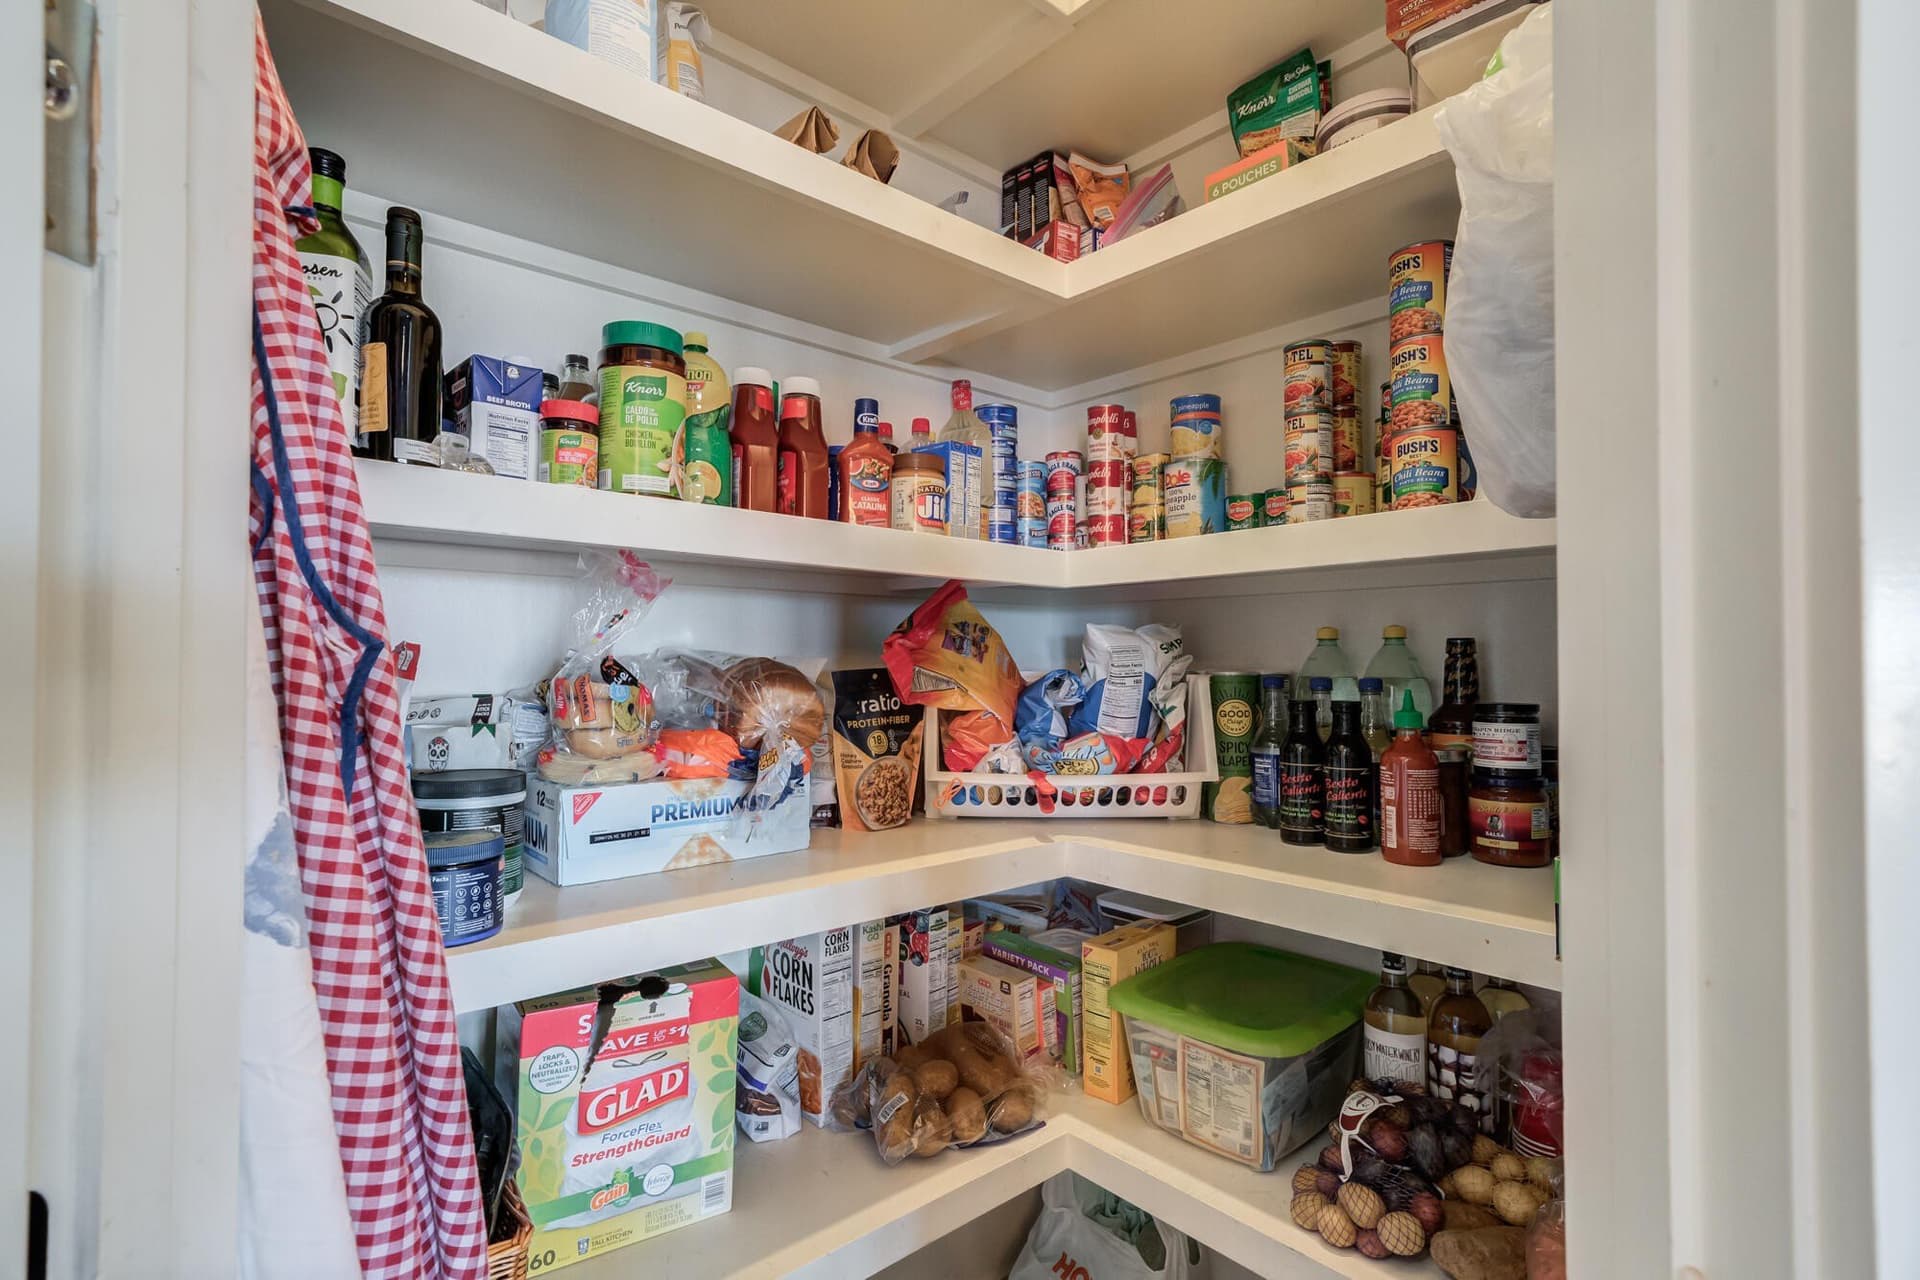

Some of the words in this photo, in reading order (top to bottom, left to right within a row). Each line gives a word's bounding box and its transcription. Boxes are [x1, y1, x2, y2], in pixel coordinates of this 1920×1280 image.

[1237, 95, 1277, 119] Knorr
[1212, 186, 1220, 197] 6
[1221, 160, 1278, 193] POUCHES
[302, 264, 343, 278] osen
[1391, 255, 1421, 277] USH'S
[625, 380, 664, 396] Knorr
[1404, 376, 1434, 386] Beans
[486, 395, 504, 404] BEEF
[505, 399, 531, 409] BROTH
[625, 405, 649, 414] CALDO
[625, 415, 634, 424] DE
[1397, 440, 1439, 458] BUSH'S
[1165, 469, 1191, 487] Dole
[1394, 469, 1412, 482] Chili
[1414, 468, 1445, 477] Beans
[1219, 709, 1251, 718] GOOD
[1219, 740, 1250, 754] SPICY
[536, 789, 546, 807] 12
[651, 795, 741, 824] PREMIUM
[862, 921, 884, 935] Kashi
[824, 929, 850, 947] CORN
[824, 942, 850, 957] FLAKES
[772, 949, 814, 991] CORN
[991, 946, 1026, 965] VARIETY
[1027, 960, 1050, 977] PACK
[772, 976, 815, 1016] FLAKES
[882, 963, 893, 1022] Granola
[538, 1060, 564, 1071] LOCKS
[542, 1053, 567, 1063] TRAPS,
[531, 1064, 577, 1080] NEUTRALIZES
[585, 1068, 685, 1128] GLAD
[601, 1121, 664, 1145] ForceFlex
[570, 1124, 692, 1168] StrengthGuard
[590, 1182, 629, 1211] Gain
